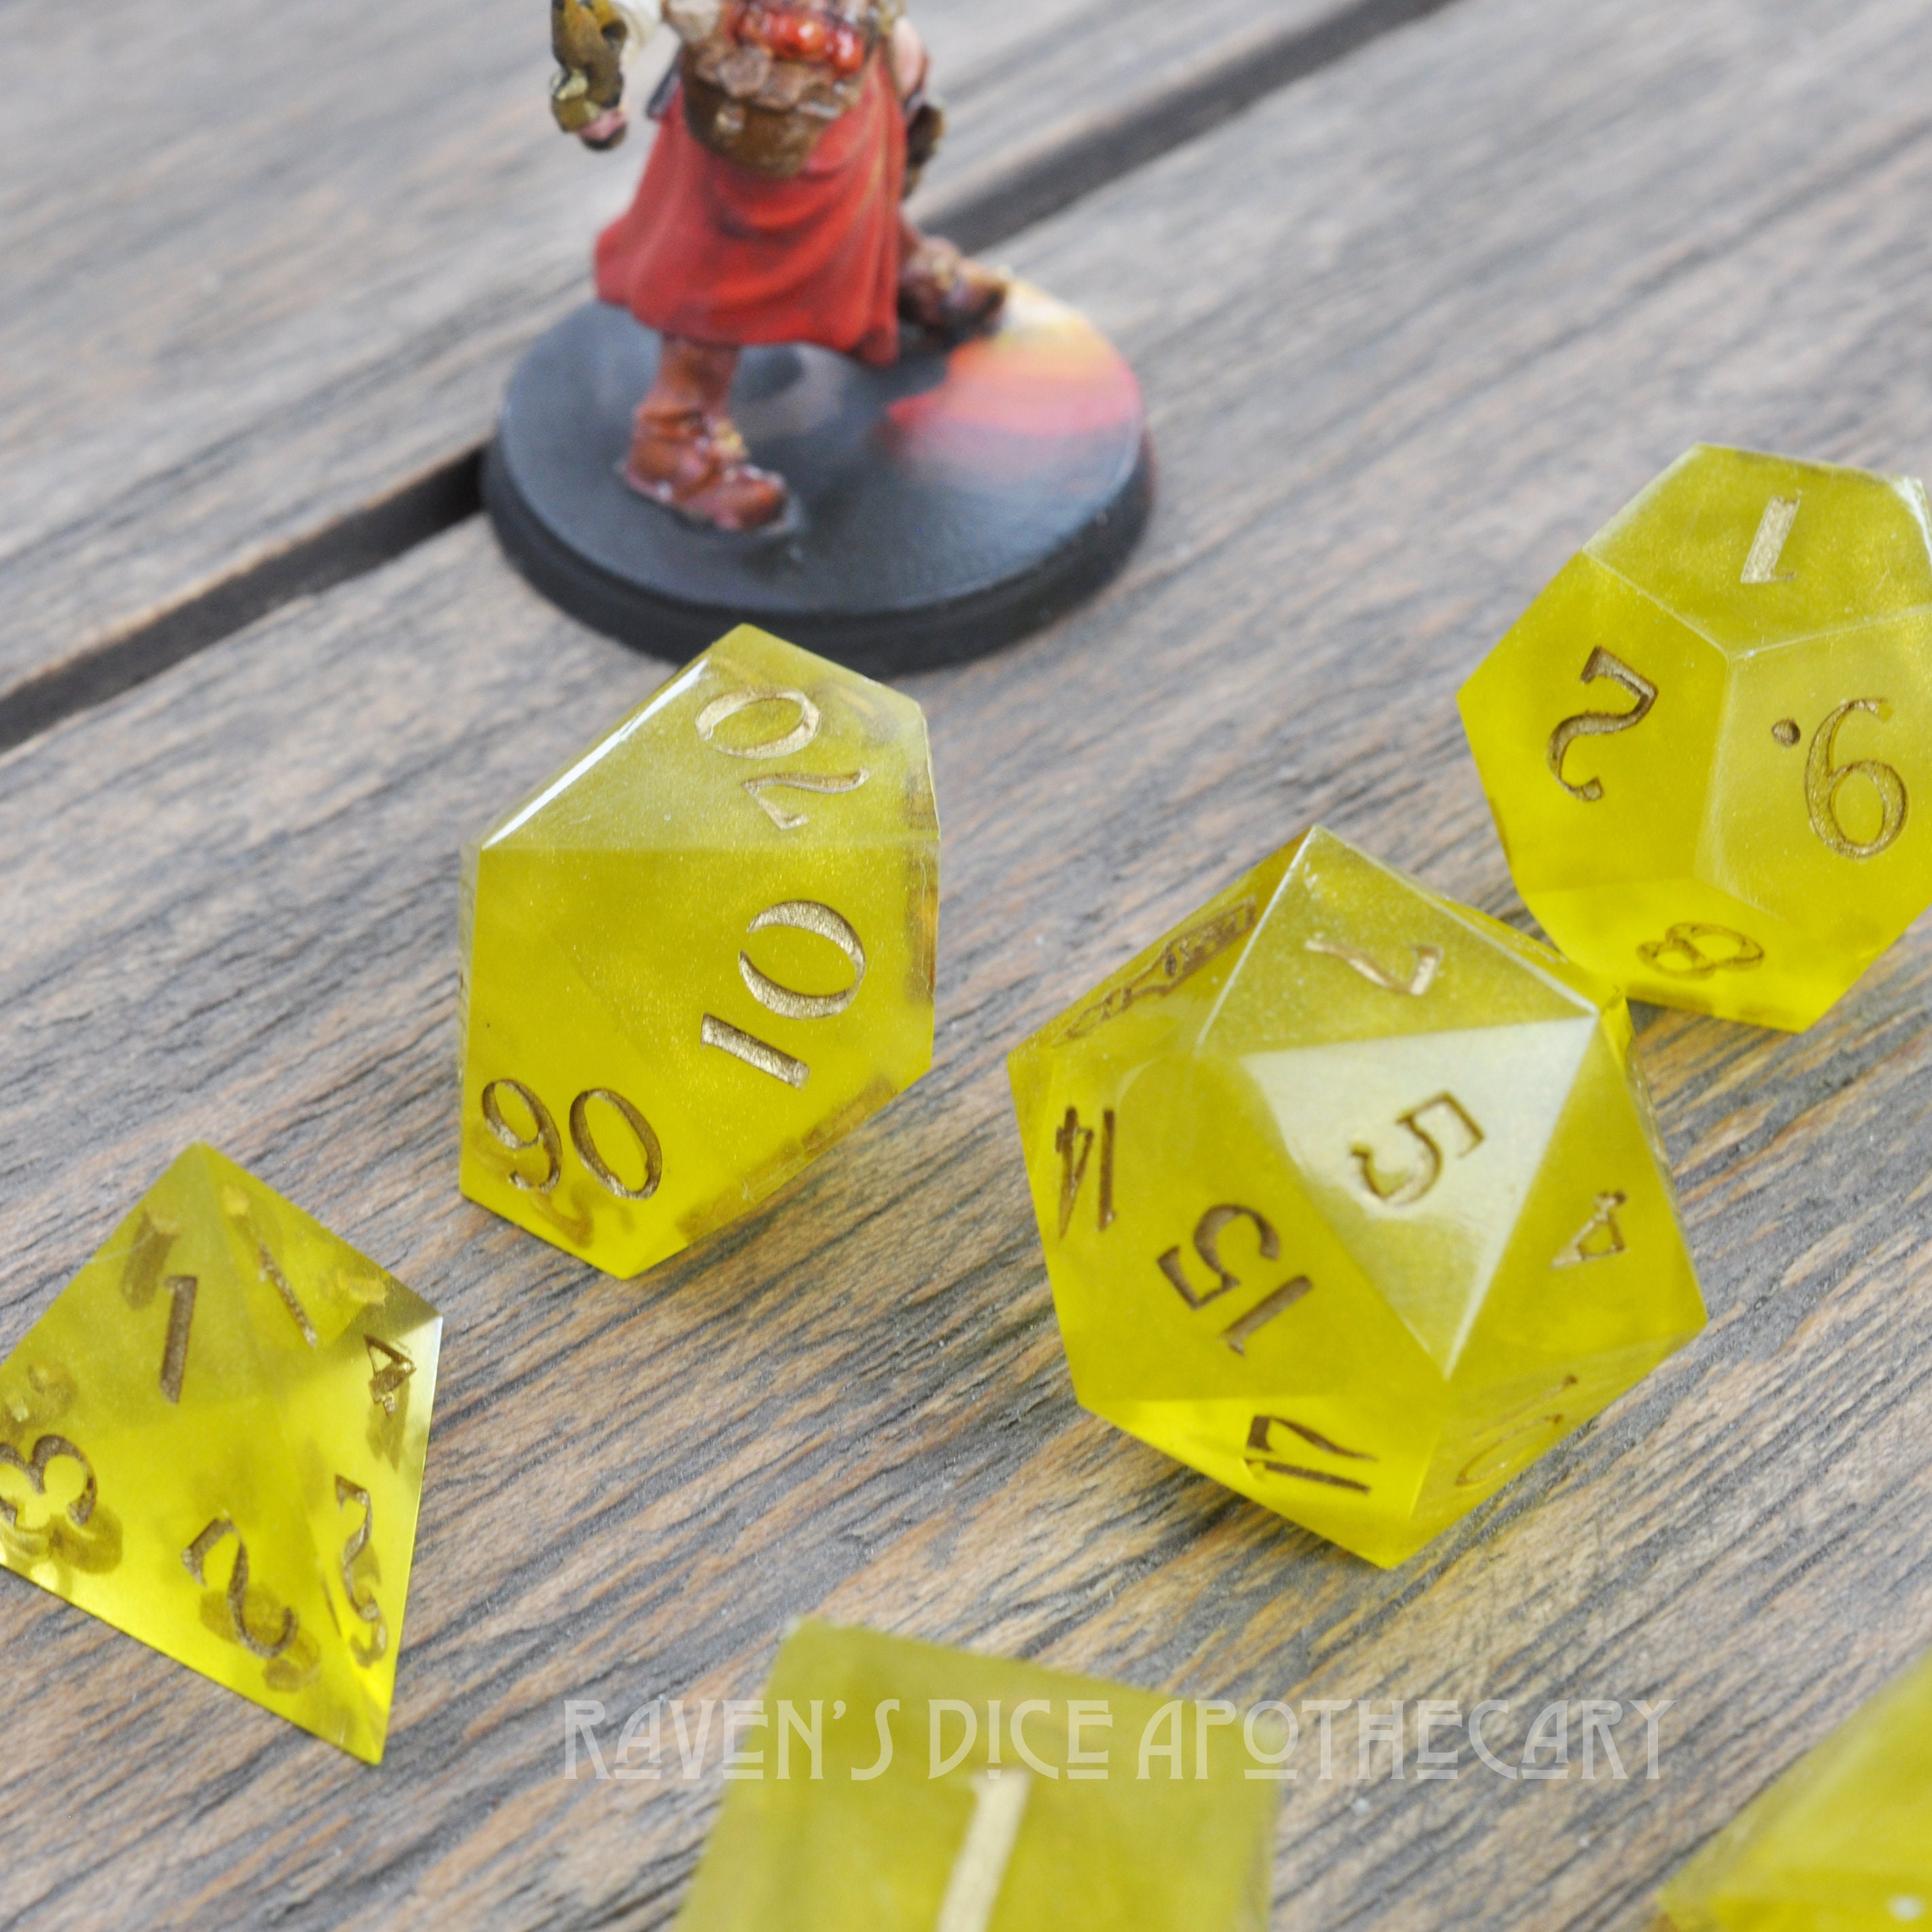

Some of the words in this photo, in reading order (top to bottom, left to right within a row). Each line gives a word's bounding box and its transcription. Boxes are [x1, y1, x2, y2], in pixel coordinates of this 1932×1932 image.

[1741, 495, 1801, 583] 1
[695, 685, 869, 831] 20
[1546, 645, 1659, 802] 2
[700, 899, 866, 1089] 10
[1637, 922, 1765, 979] 8
[481, 1078, 663, 1201] 90
[1054, 1105, 1117, 1243] 14
[1350, 1091, 1484, 1209] 5
[160, 1274, 198, 1406] 1
[1156, 1202, 1314, 1357] 15
[0, 1434, 97, 1529] 3
[1243, 1414, 1380, 1496] 17
